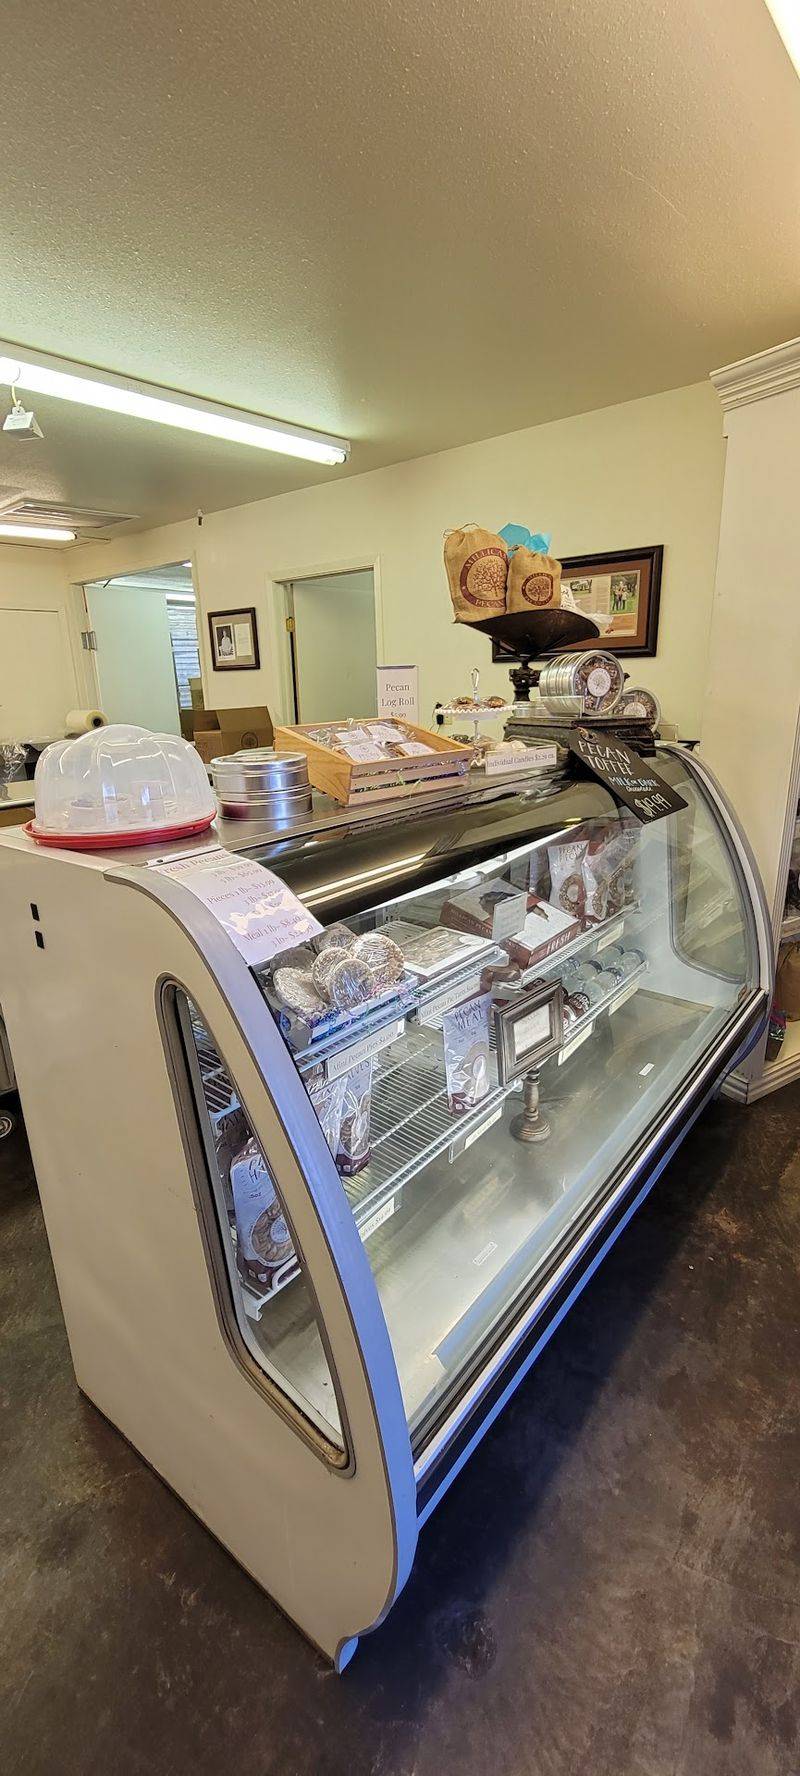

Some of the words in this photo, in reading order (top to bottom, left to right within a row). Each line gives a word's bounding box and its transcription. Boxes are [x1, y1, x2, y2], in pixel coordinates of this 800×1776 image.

[381, 699, 397, 707] Log
[398, 697, 415, 706] Roll
[578, 741, 631, 765] PECAN
[583, 755, 635, 776] TOFFEE
[608, 776, 632, 787] MILK
[634, 793, 672, 818] $19.99
[546, 931, 570, 955] FRESH
[454, 1000, 482, 1021] PECAN
